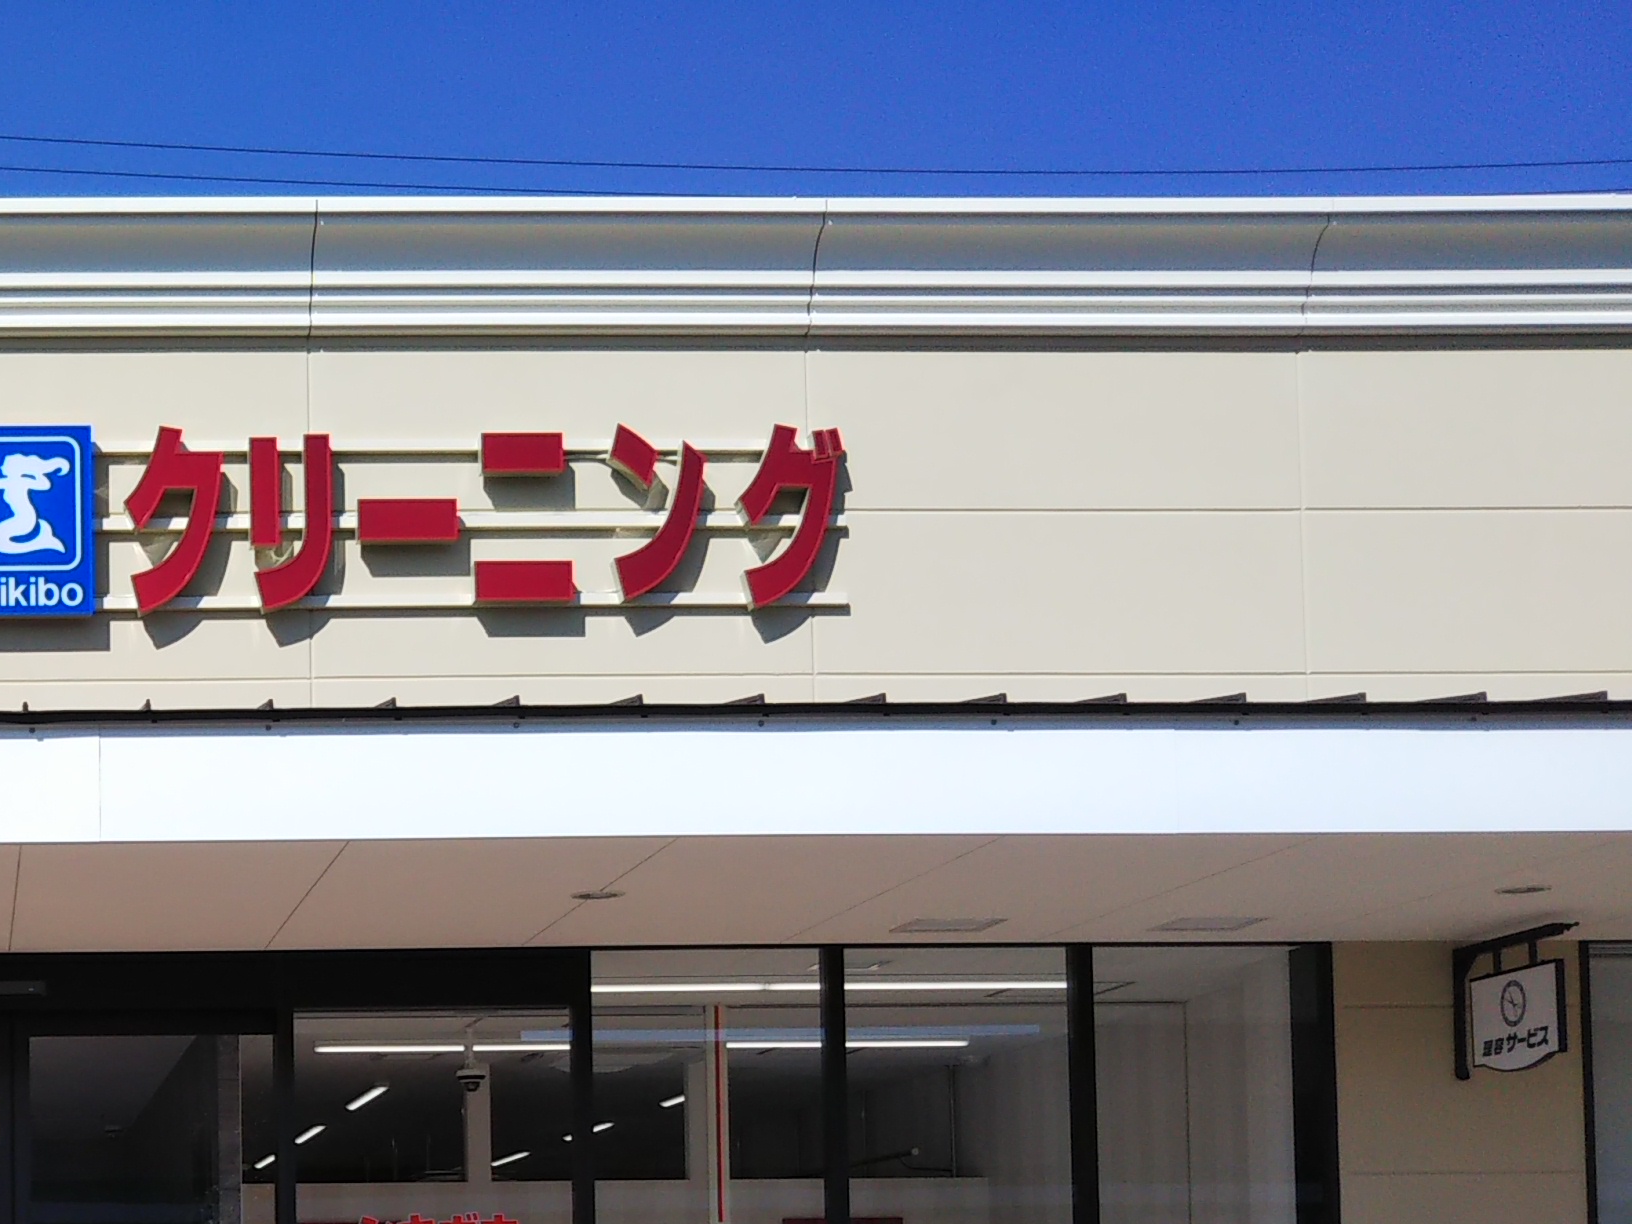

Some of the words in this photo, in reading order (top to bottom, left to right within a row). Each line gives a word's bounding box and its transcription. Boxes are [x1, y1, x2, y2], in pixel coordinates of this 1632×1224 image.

[123, 423, 844, 616] クリーニング
